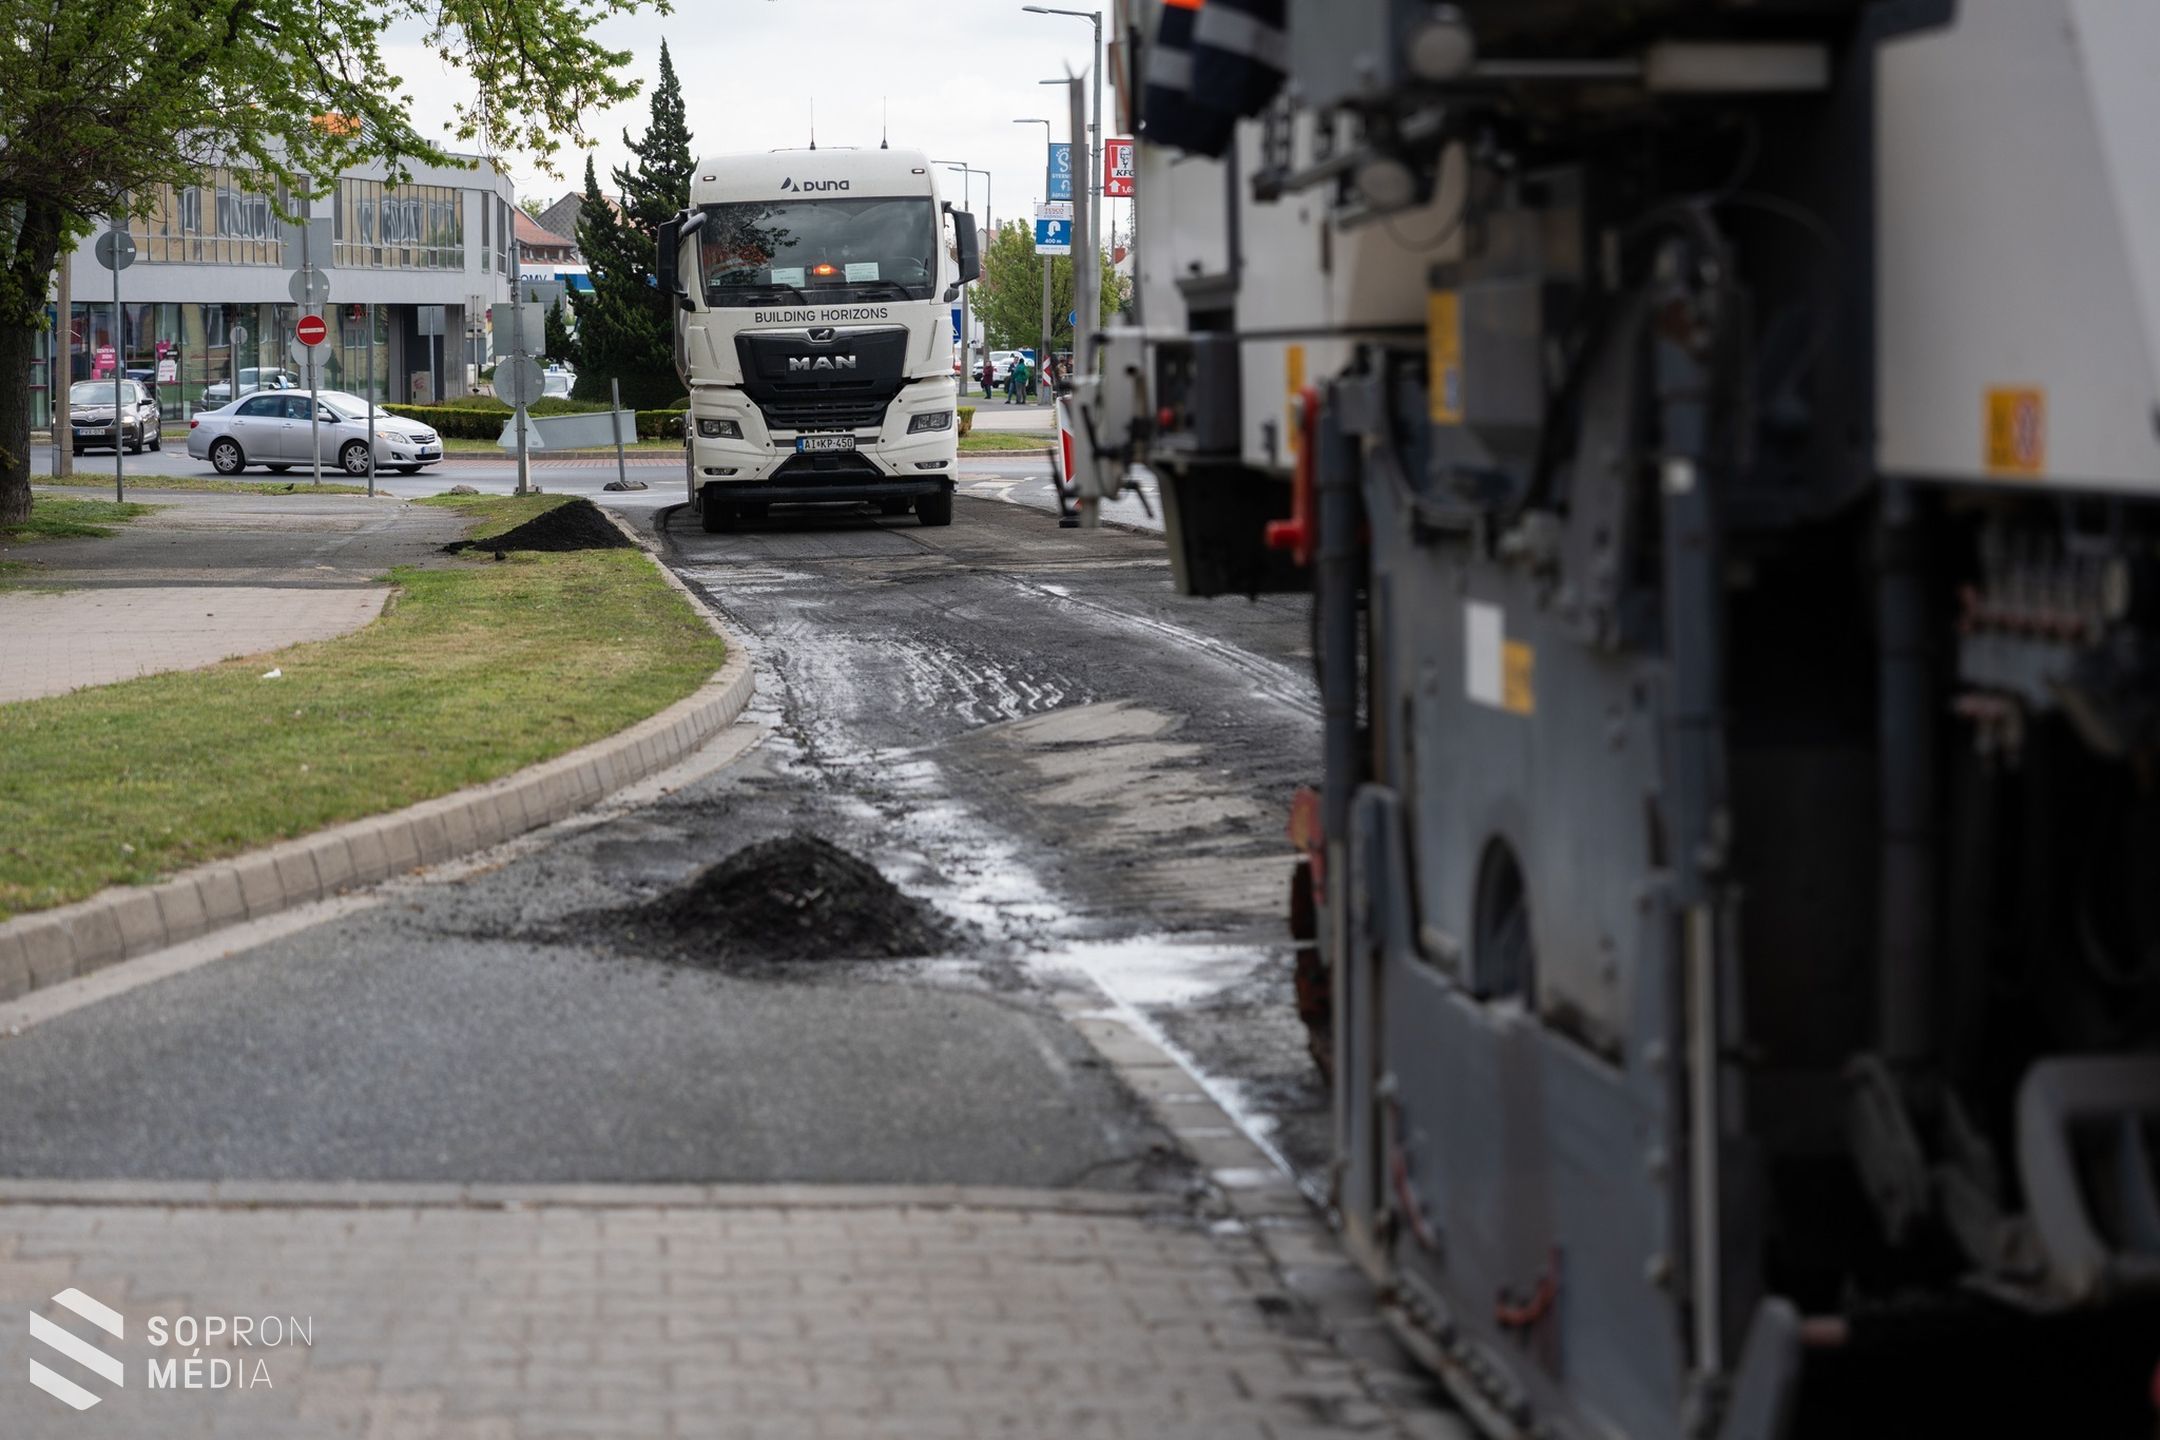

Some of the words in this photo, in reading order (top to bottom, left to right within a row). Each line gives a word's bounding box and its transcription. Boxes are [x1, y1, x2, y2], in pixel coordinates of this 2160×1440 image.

[754, 310, 816, 323] BUILDING
[820, 307, 889, 321] HORIZONS
[788, 355, 857, 371] MAN
